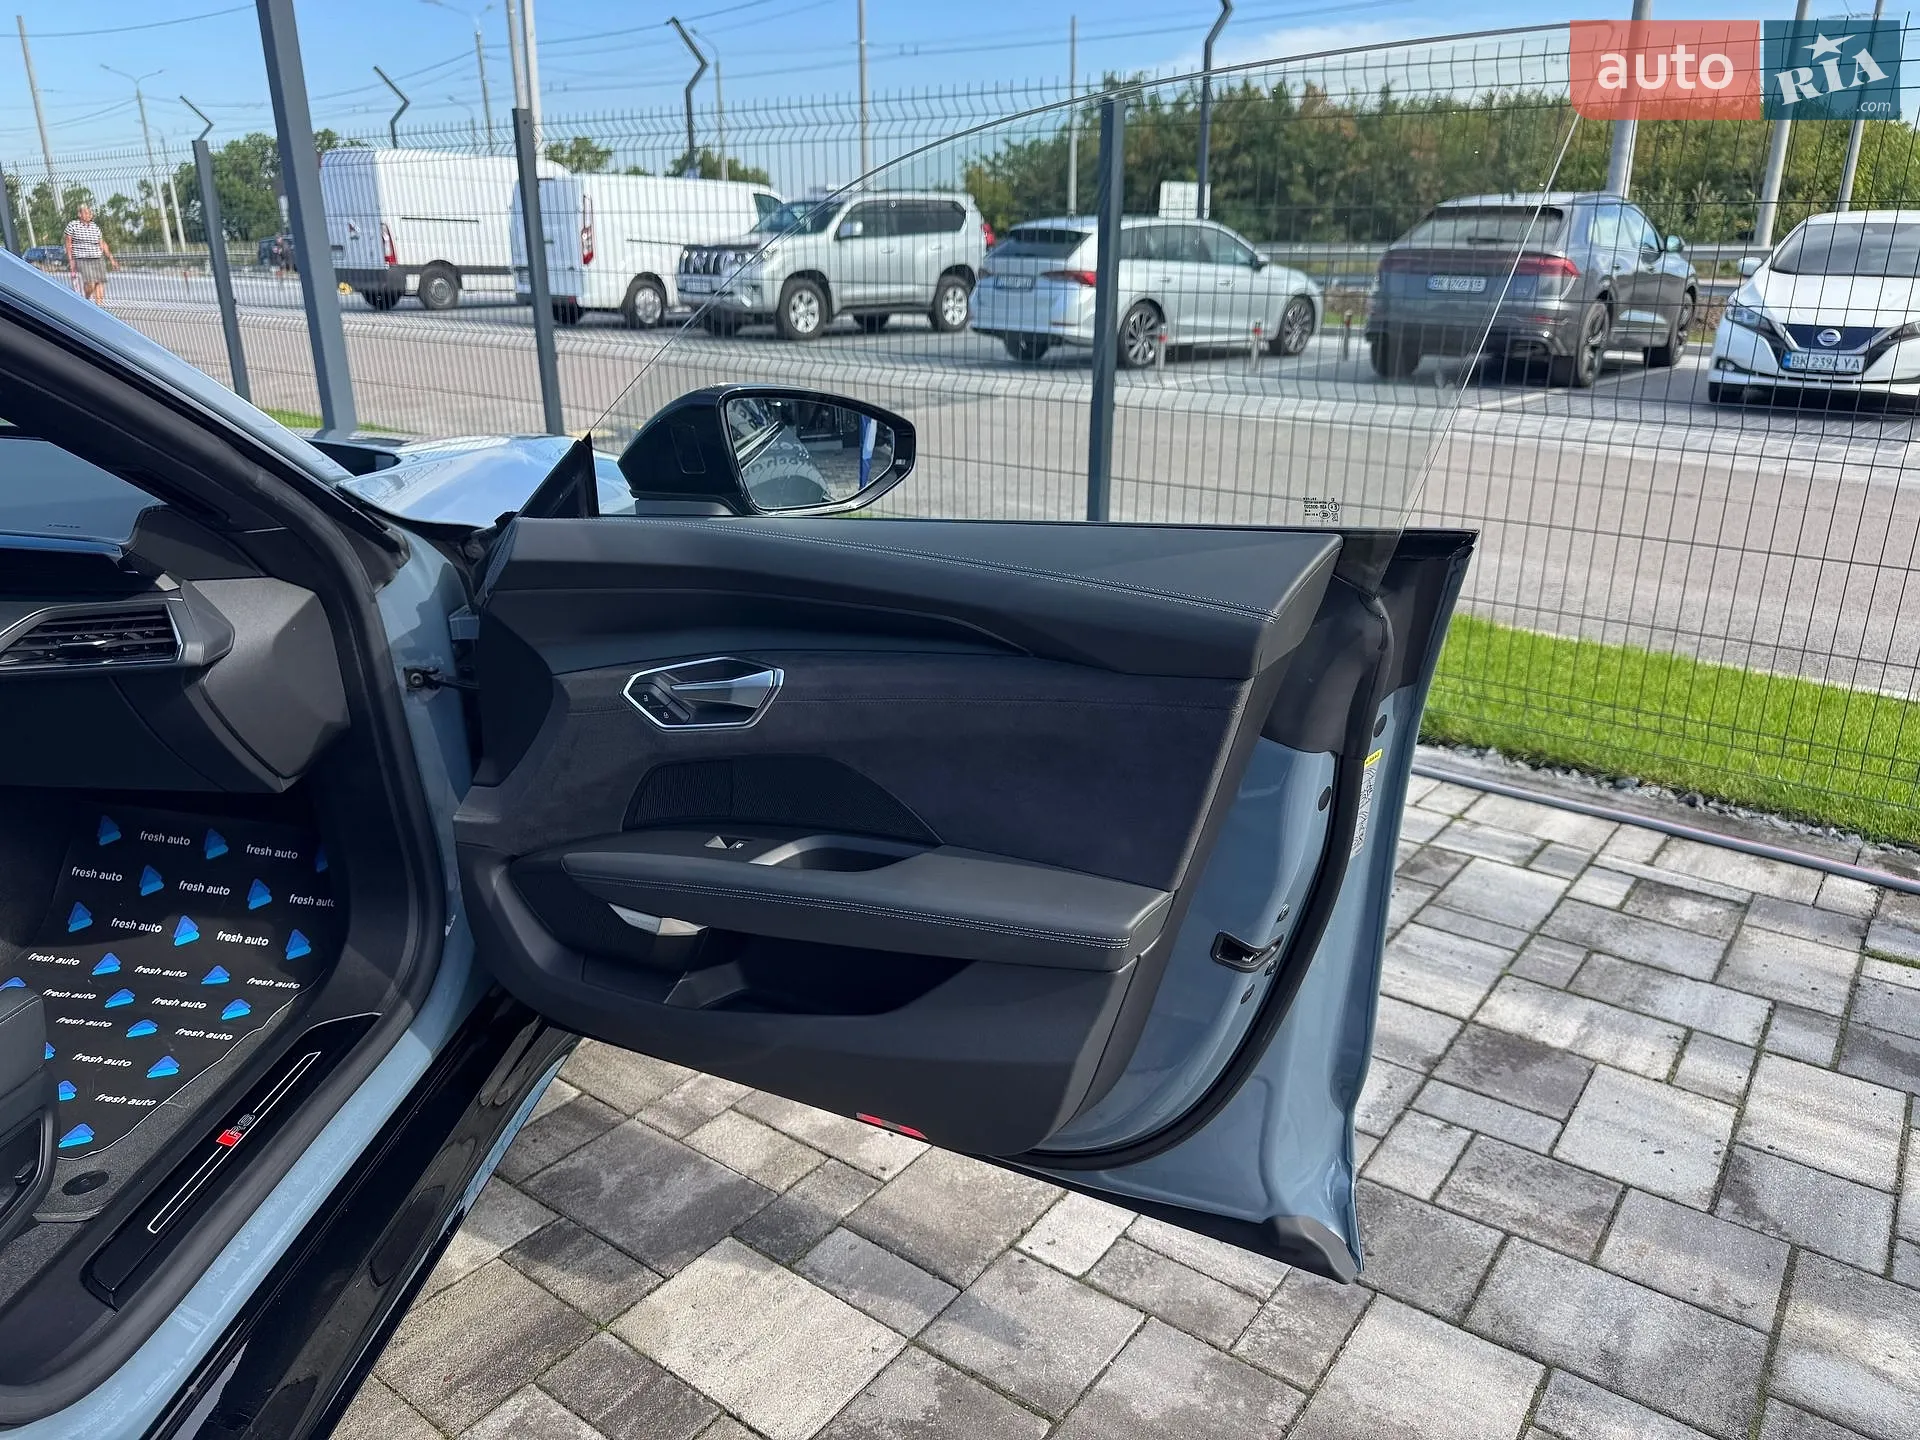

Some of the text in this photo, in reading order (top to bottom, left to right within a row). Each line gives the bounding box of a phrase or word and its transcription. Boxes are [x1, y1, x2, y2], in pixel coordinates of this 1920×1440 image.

[1844, 357, 1860, 370] YA
[140, 830, 191, 846] fresh auto
[246, 843, 299, 860] fresh auto
[71, 866, 123, 882] fresh auto
[178, 880, 231, 896] fresh auto
[289, 893, 315, 906] fresh
[110, 917, 163, 933] fresh auto
[216, 930, 269, 947] fresh auto
[27, 952, 81, 966] fresh auto
[134, 965, 188, 978] fresh auto
[246, 977, 301, 989] fresh auto
[42, 988, 97, 1000] fresh auto
[151, 996, 207, 1009] fresh auto
[55, 1016, 113, 1028] fresh auto
[174, 1027, 234, 1041] fresh auto
[72, 1052, 132, 1067] fresh auto
[94, 1093, 157, 1106] fresh auto
